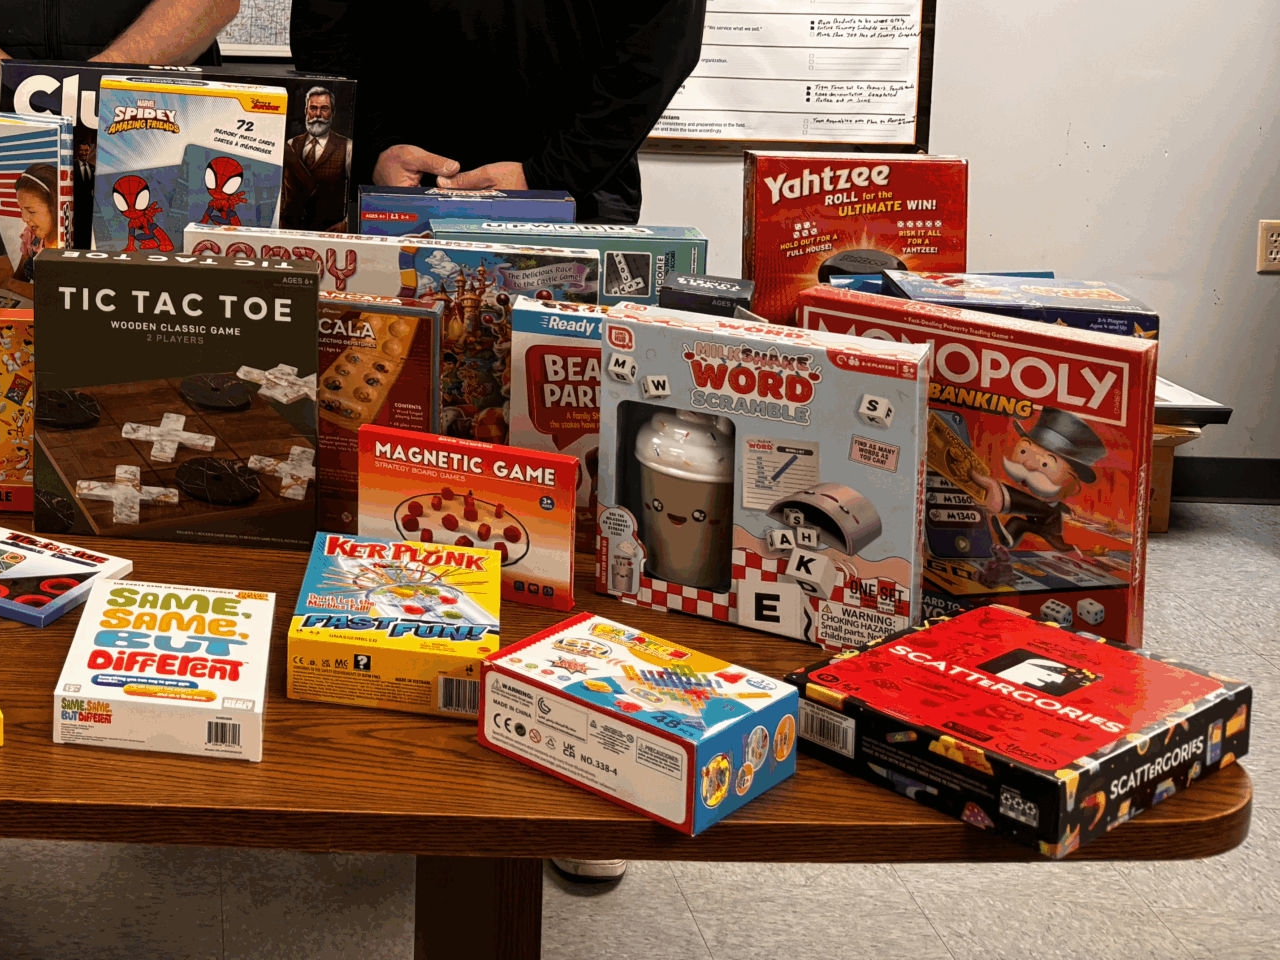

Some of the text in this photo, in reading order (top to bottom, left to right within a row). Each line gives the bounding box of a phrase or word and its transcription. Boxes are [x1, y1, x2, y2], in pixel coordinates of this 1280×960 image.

[137, 99, 155, 108] MARVEL
[113, 107, 177, 122] SPIDEY
[108, 120, 180, 134] AMAZING FRIENDS
[214, 128, 238, 137] MEMORY
[237, 120, 254, 132] 72
[764, 164, 890, 204] Yahtzee
[825, 192, 858, 205] ROLL
[838, 199, 936, 217] ULTIMATE WIN!
[508, 269, 553, 280] The Delicious
[536, 277, 558, 286] Castle
[58, 286, 292, 322] TIC TAC TOE
[111, 320, 240, 336] WOODEN CLASSIC GAME
[549, 315, 595, 335] Ready
[944, 323, 968, 333] Property
[970, 328, 991, 337] Trading
[156, 334, 204, 345] PLAYERS
[695, 341, 811, 372] MILKSHAKE
[690, 359, 815, 404] WORD
[692, 390, 810, 424] SCRAMBLE
[930, 382, 1032, 418] BANKING
[859, 447, 879, 457] WORDS
[860, 453, 871, 461] YOU
[878, 446, 895, 455] MANY
[375, 440, 555, 486] MAGNETIC GAME
[375, 461, 465, 482] STRATEGY BOARD GAMES
[947, 512, 976, 520] M1340
[106, 588, 252, 619] SAME,
[754, 592, 781, 623] E
[302, 615, 396, 630] FAST
[842, 607, 896, 628] WARNING:
[389, 623, 487, 641] FUN!
[93, 630, 248, 657] BUT
[888, 645, 1125, 734] SCATTERGORIES
[493, 699, 532, 718] MADE CHINA
[581, 754, 617, 776] NO.338-4
[1110, 736, 1204, 800] SCATTERGORIES
